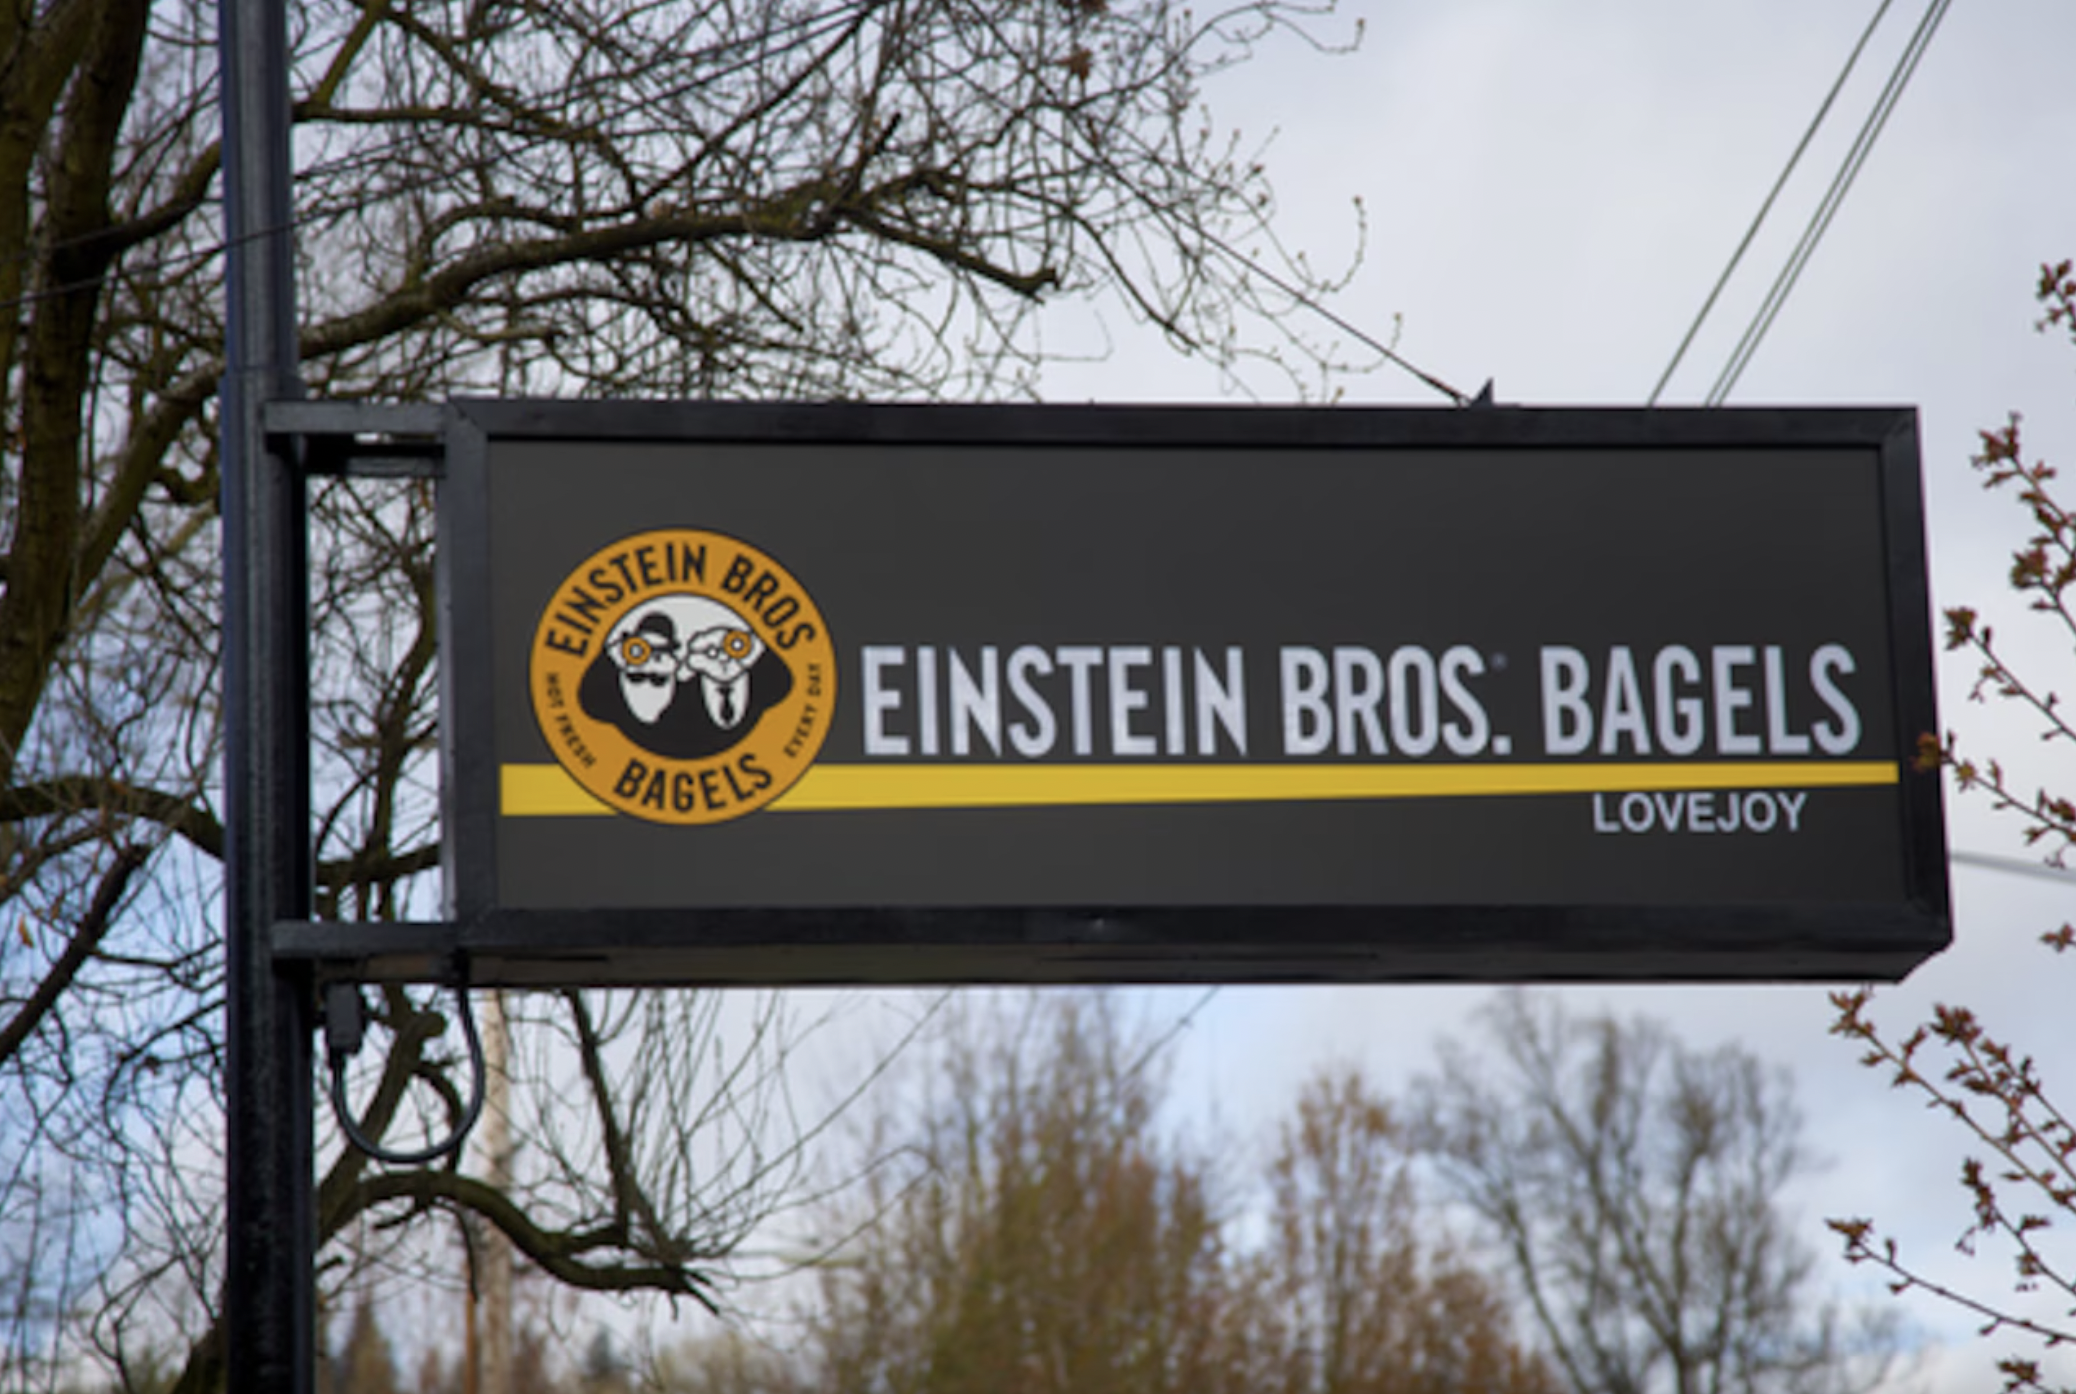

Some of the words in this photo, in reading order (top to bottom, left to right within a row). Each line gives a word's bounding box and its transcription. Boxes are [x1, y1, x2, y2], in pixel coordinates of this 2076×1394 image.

[546, 541, 707, 658] EINSTEIN
[721, 554, 816, 650] BROS
[545, 672, 565, 709] HOT
[861, 645, 1248, 757] EINSTEIN
[1280, 644, 1512, 756] BROS.
[1540, 643, 1861, 755] BAGELS
[612, 753, 773, 814] BAGELS
[1593, 791, 1807, 833] LOVEJOY
